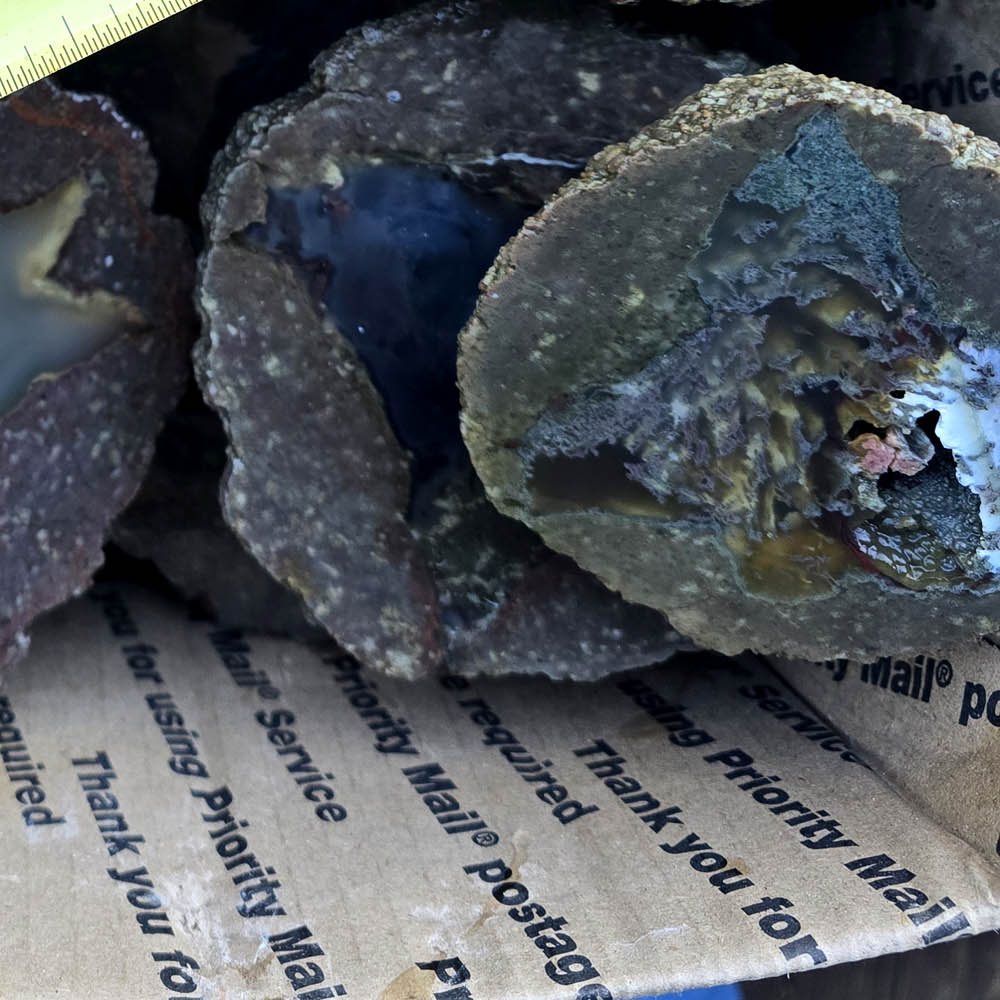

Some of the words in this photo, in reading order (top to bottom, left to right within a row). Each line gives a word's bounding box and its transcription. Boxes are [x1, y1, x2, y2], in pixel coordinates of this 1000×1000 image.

[72, 750, 145, 856] Thank
[255, 709, 347, 822] Service
[321, 652, 420, 755] Priority
[403, 762, 499, 848] Mail®
[458, 699, 598, 825] required
[617, 679, 716, 747] using
[703, 748, 859, 850] Priority
[844, 853, 971, 944] Mail
[121, 644, 163, 684] for
[145, 692, 209, 778] using
[191, 786, 287, 918] Priority
[269, 924, 348, 1000] Mai
[572, 738, 684, 833] Thank
[660, 832, 755, 895] you
[741, 897, 827, 965] for
[107, 866, 175, 936] you
[152, 950, 200, 1000] fo
